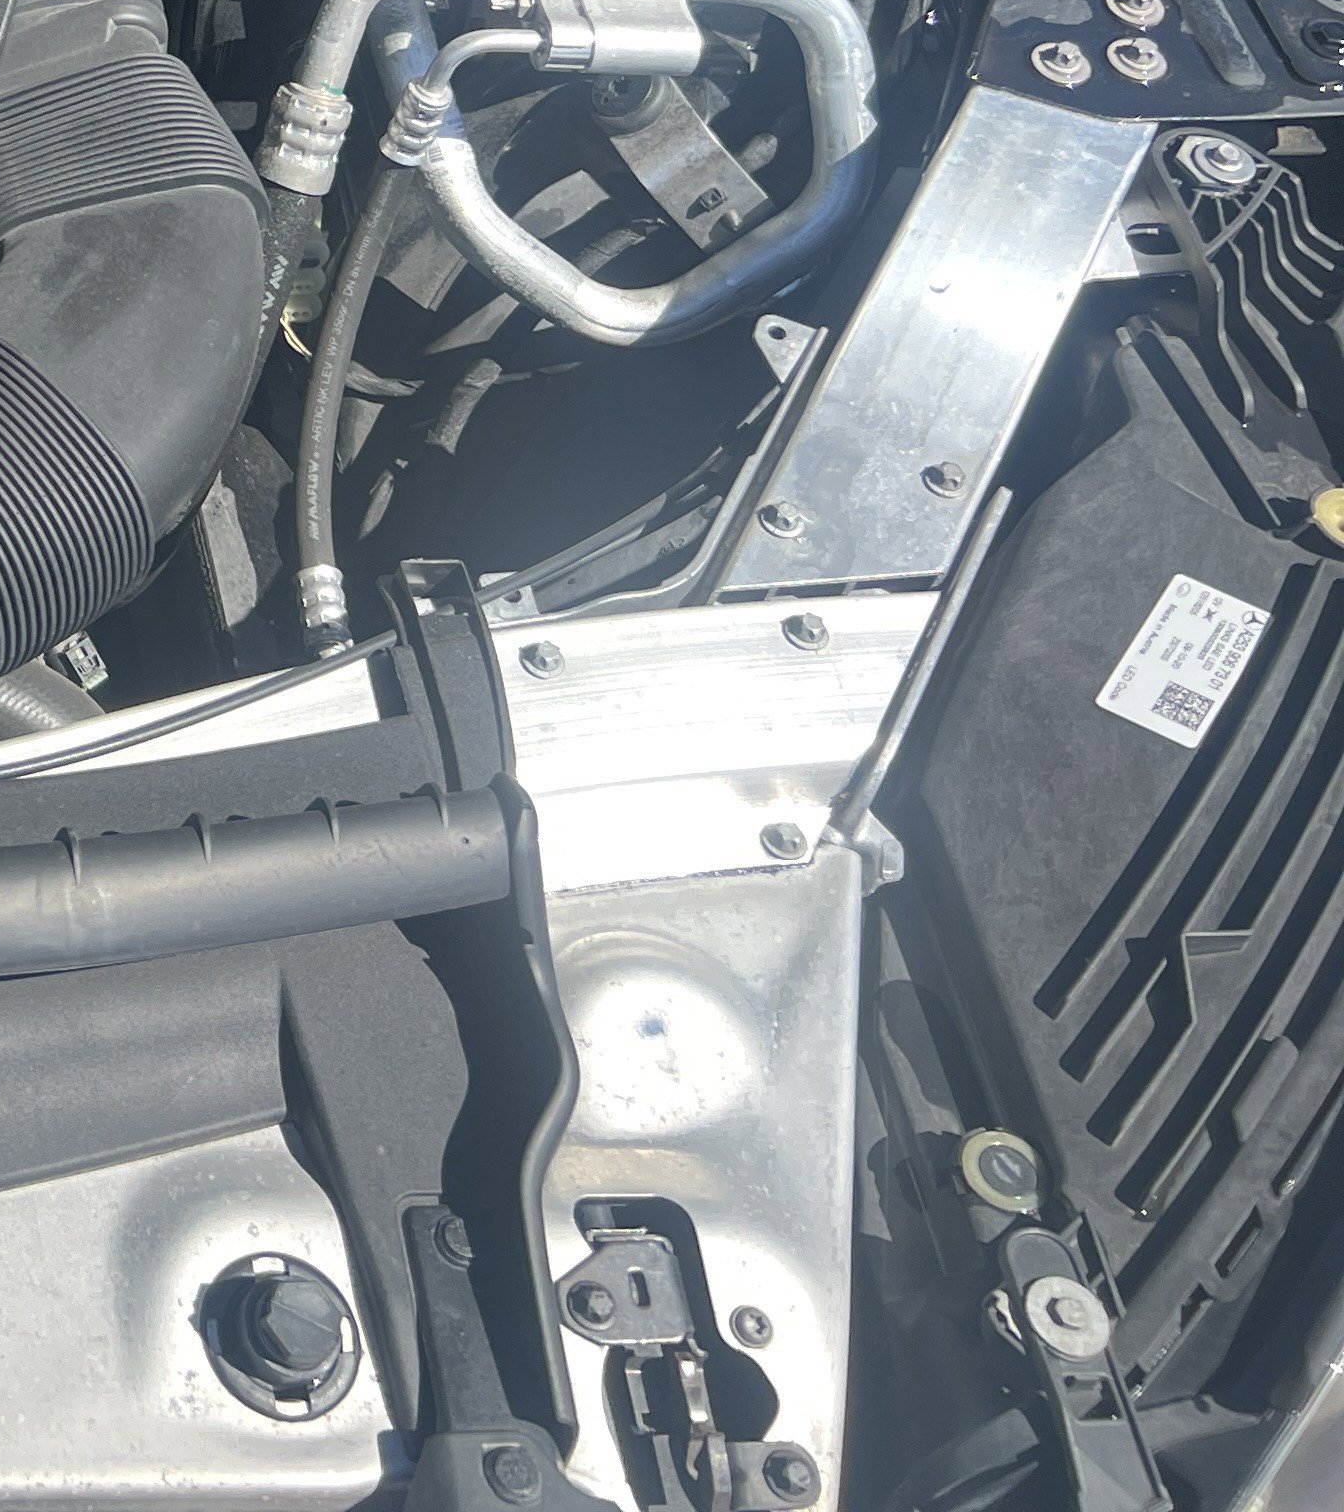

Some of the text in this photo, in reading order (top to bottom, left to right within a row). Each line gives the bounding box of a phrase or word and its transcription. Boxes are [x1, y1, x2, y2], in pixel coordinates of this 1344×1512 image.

[311, 406, 325, 442] ARTIC
[321, 361, 333, 385] LEV
[327, 336, 339, 356] WP
[343, 281, 356, 297] DN
[367, 208, 383, 229] SAE
[1159, 603, 1178, 623] Made
[1232, 628, 1254, 652] A253
[1222, 650, 1242, 669] 906
[1122, 664, 1138, 682] LED
[1215, 666, 1231, 681] 73
